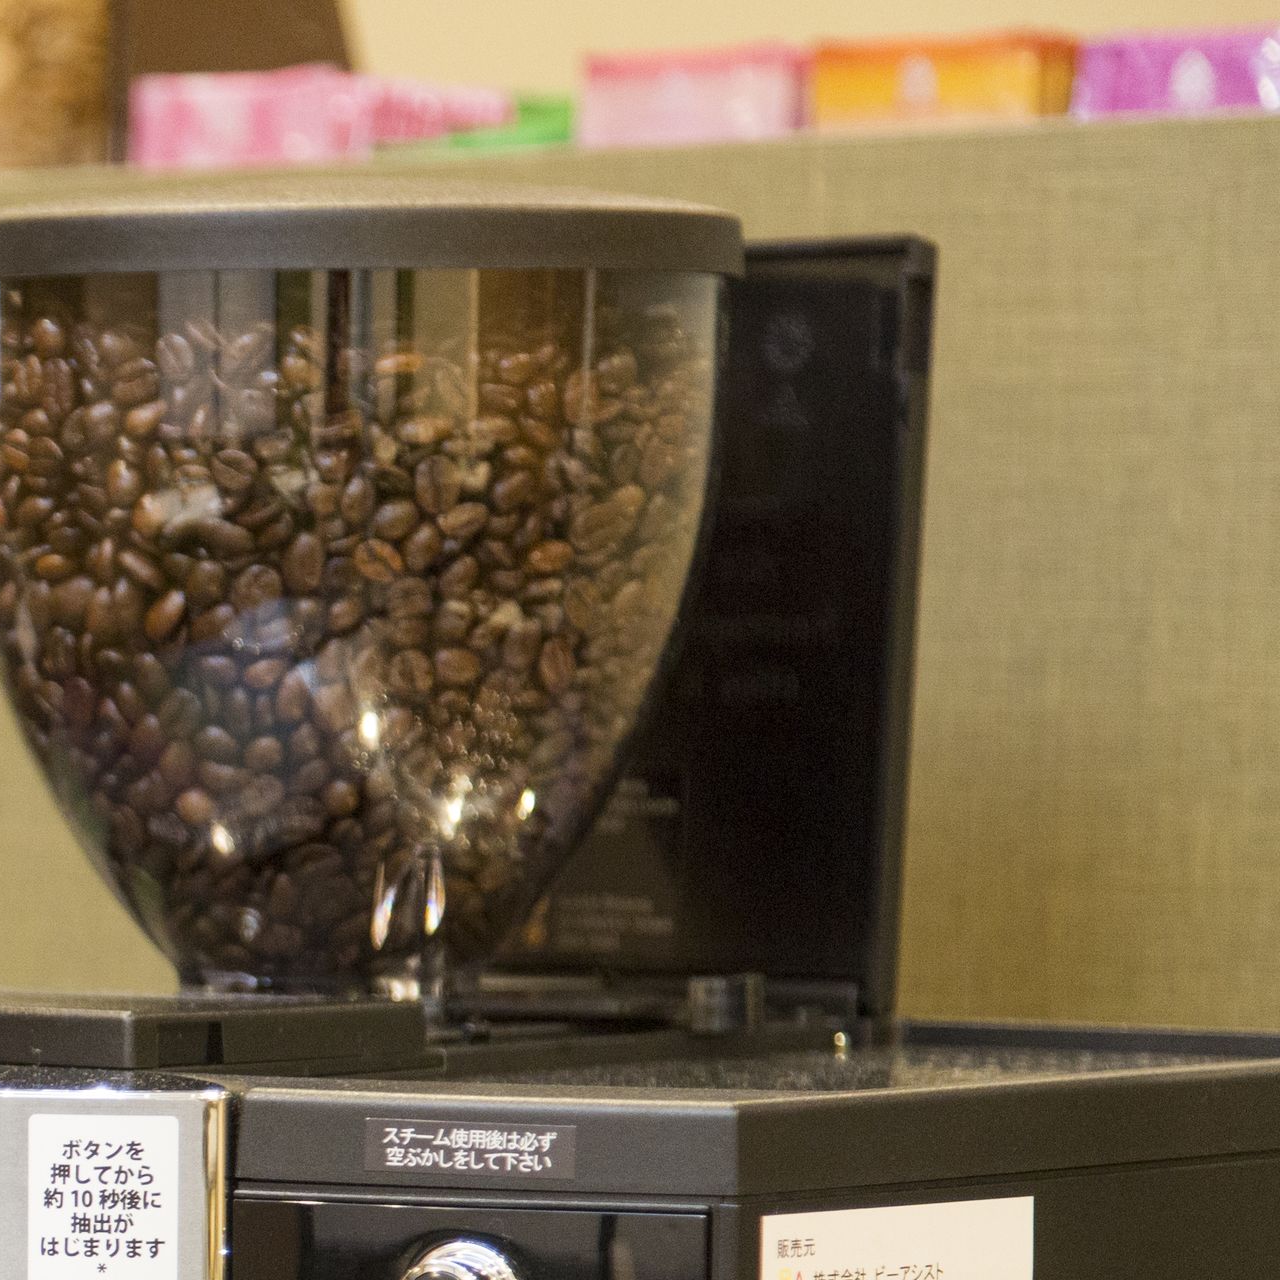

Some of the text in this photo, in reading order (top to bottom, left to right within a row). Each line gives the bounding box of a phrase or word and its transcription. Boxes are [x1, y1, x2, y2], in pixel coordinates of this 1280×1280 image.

[382, 1127, 558, 1152] スチーム使用後は必ず
[61, 1140, 145, 1161] ボタンを
[385, 1146, 552, 1172] 空ぶかしをして下さい
[50, 1163, 155, 1185] 押してから
[71, 1213, 134, 1234] 抽出が
[40, 1237, 165, 1258] はじまります
[777, 1238, 816, 1259] 販売元
